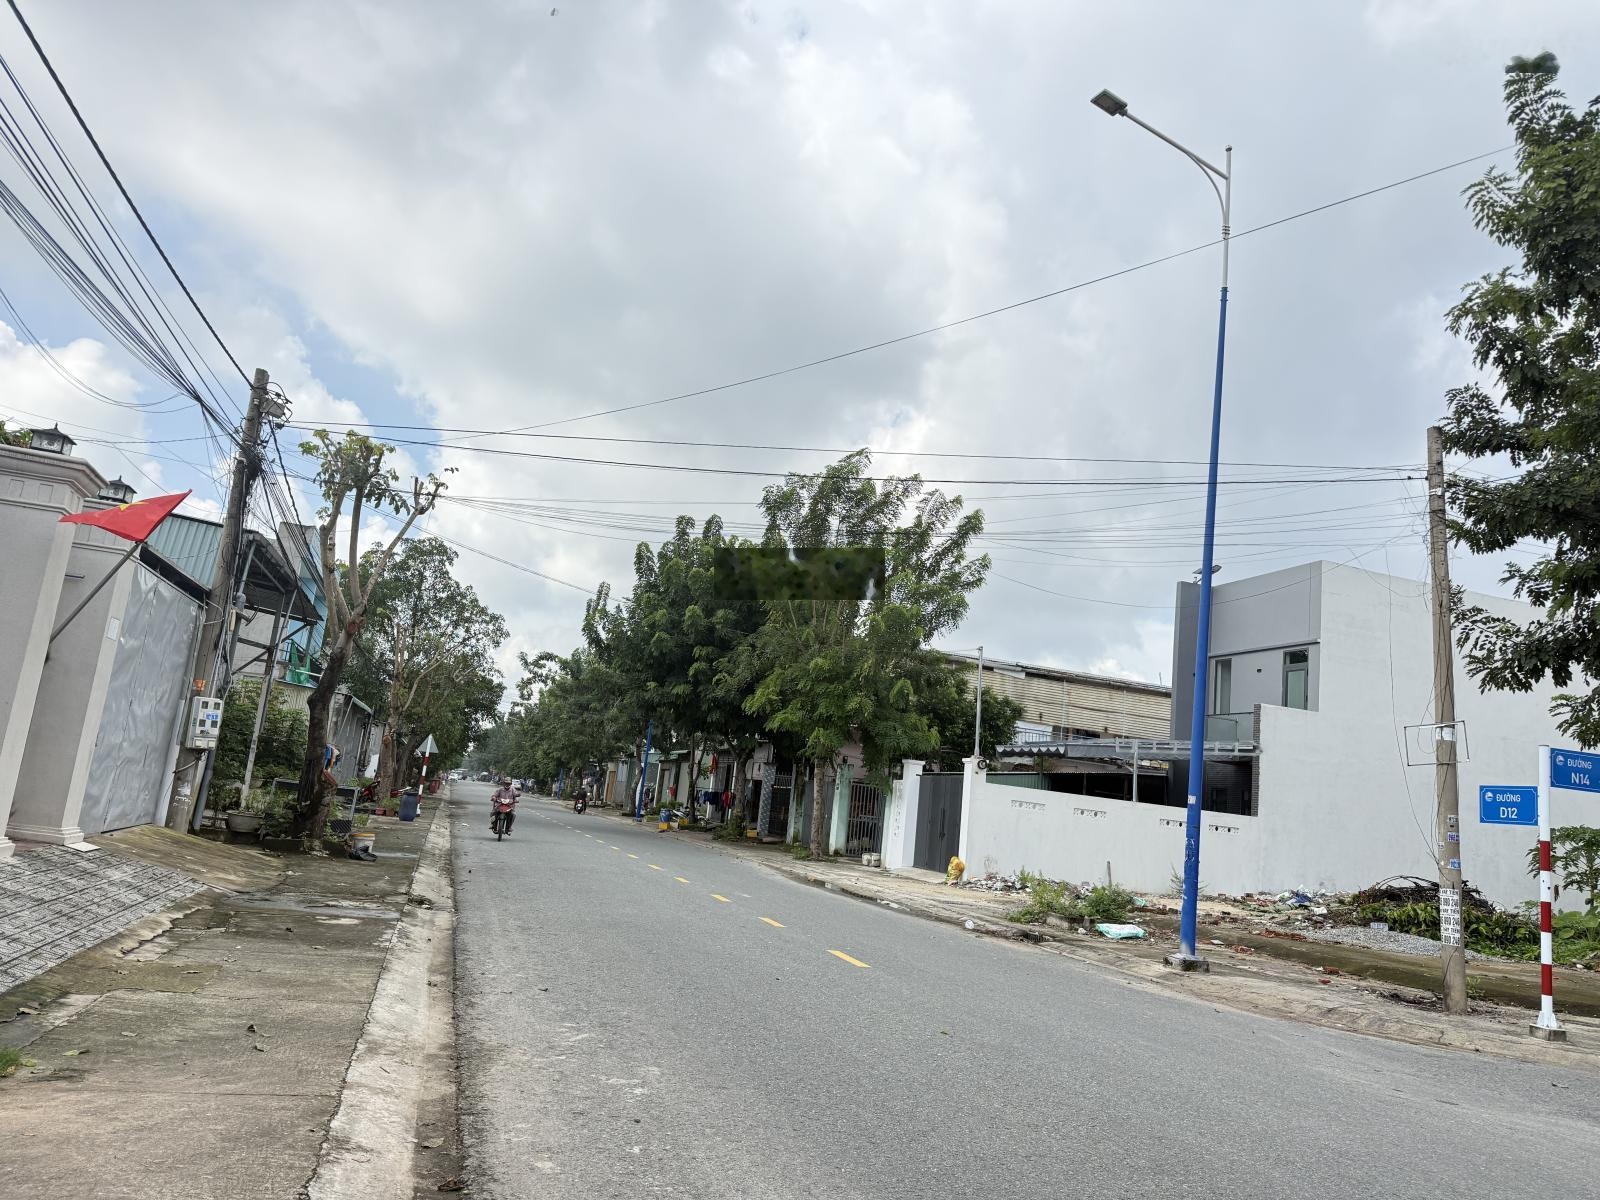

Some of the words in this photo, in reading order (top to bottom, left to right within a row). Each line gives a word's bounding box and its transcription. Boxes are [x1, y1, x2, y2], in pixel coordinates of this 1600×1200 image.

[1567, 758, 1593, 770] ĐƯỜNG
[1571, 772, 1590, 785] N14
[1496, 792, 1521, 802] ĐƯỜNG
[1499, 806, 1518, 819] D12
